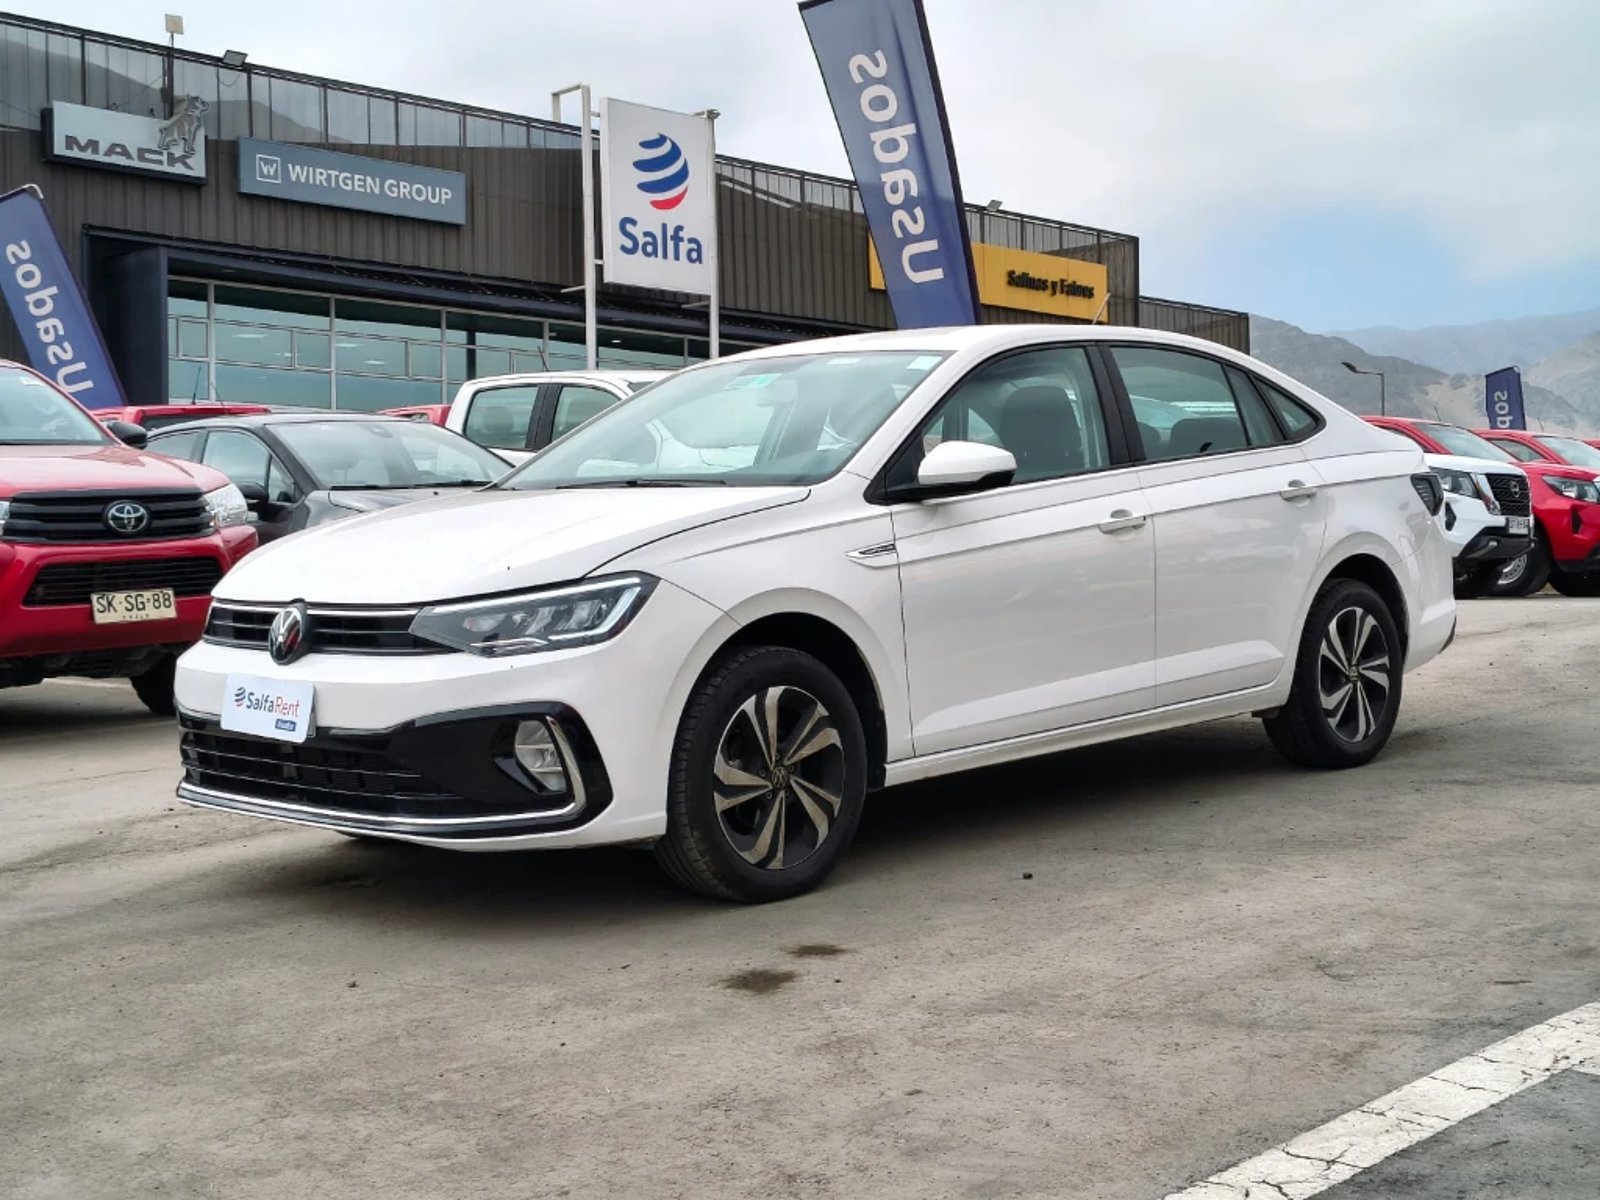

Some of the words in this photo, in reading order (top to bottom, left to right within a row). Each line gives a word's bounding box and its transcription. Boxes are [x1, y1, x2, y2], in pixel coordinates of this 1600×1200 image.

[65, 134, 194, 171] MACK
[287, 163, 381, 195] WIRTGEN
[384, 178, 453, 205] GROUP
[618, 216, 703, 265] Salfa
[1050, 279, 1058, 297] y
